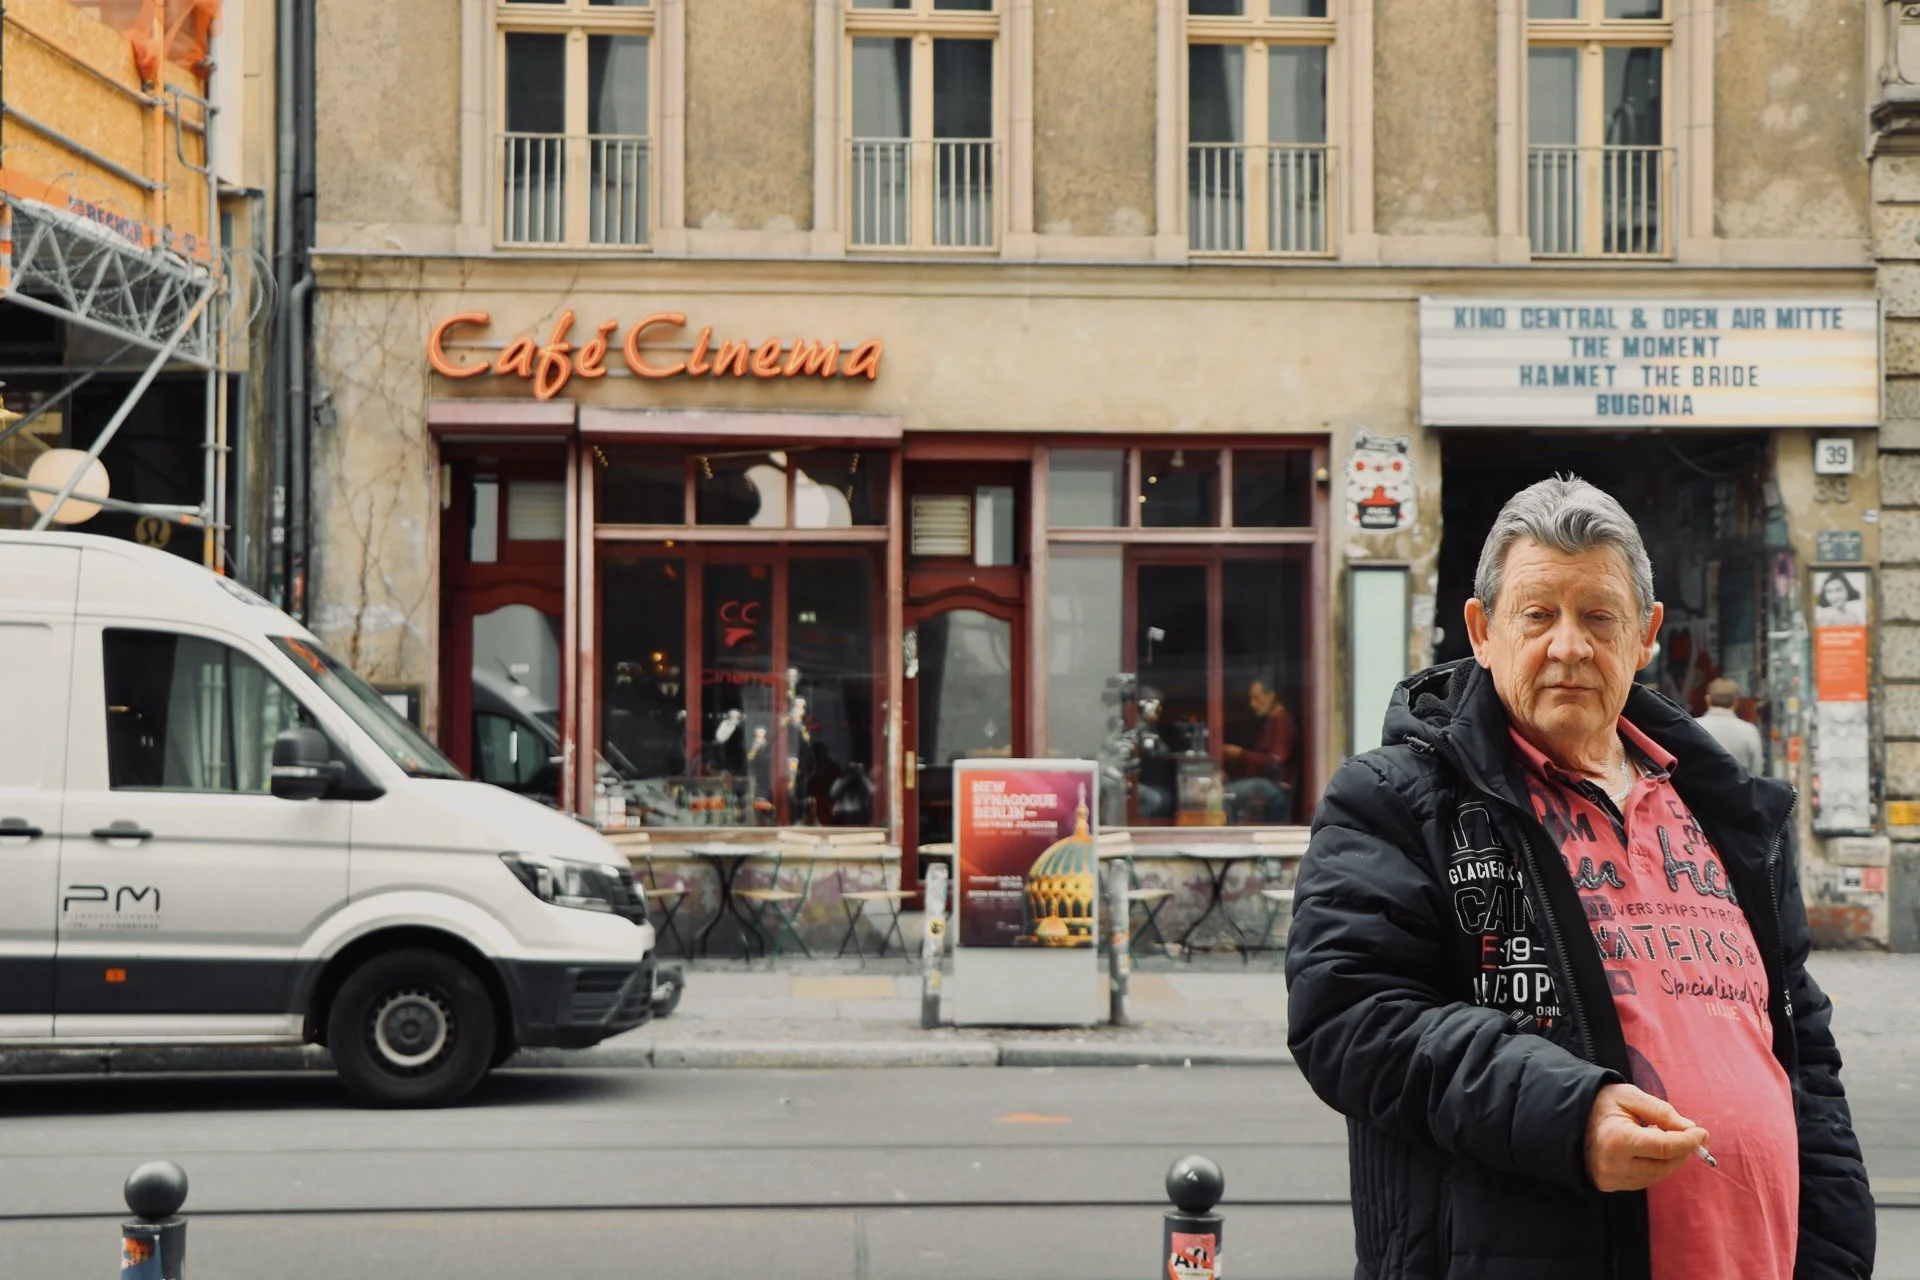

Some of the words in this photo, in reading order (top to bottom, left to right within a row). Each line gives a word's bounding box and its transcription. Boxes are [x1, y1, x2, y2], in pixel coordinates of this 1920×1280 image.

[1453, 307, 1506, 330] KINO
[1520, 307, 1617, 330] CENTRAL
[1631, 308, 1648, 330] &
[1662, 307, 1718, 330] OPEN
[1731, 308, 1766, 330] AIR
[1776, 308, 1843, 330] MITTE
[427, 310, 617, 401] Café
[624, 311, 883, 380] Cinema
[1569, 336, 1609, 358] THE
[1622, 336, 1721, 358] MOMENT
[1519, 365, 1616, 387] HAMNET
[1641, 365, 1681, 387] THE
[1692, 365, 1759, 387] BRIDE
[1596, 394, 1694, 416] BUGONIA
[1826, 446, 1848, 465] 39
[971, 780, 1006, 794] NEW
[971, 793, 1057, 808] SYNAGOGUE
[1448, 860, 1505, 885] GLACIER
[63, 885, 160, 912] PM
[1656, 903, 1698, 918] SHIPS
